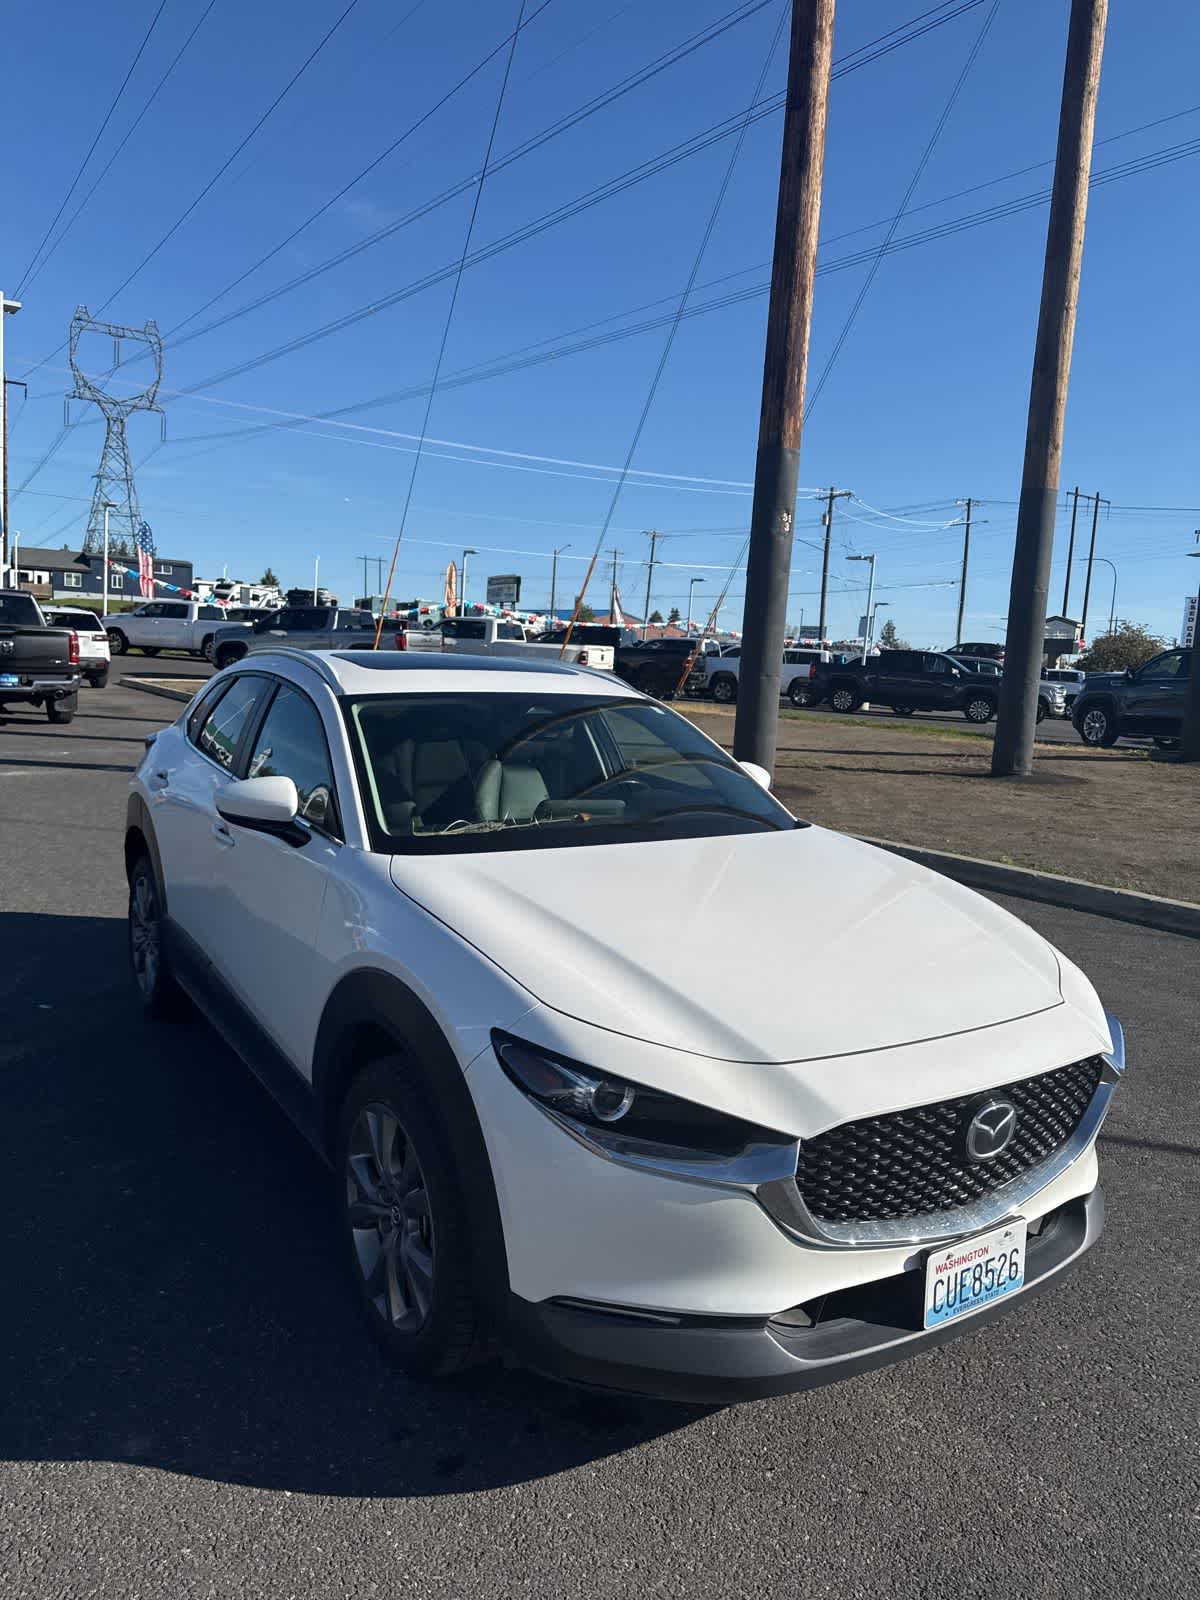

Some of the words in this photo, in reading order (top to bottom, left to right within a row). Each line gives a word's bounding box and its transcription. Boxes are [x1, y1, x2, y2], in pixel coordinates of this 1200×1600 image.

[935, 1245, 989, 1274] WASHINGTON
[933, 1248, 1019, 1314] CUE8526
[953, 1297, 984, 1314] EVERGREEN
[984, 1289, 1000, 1303] STATE
